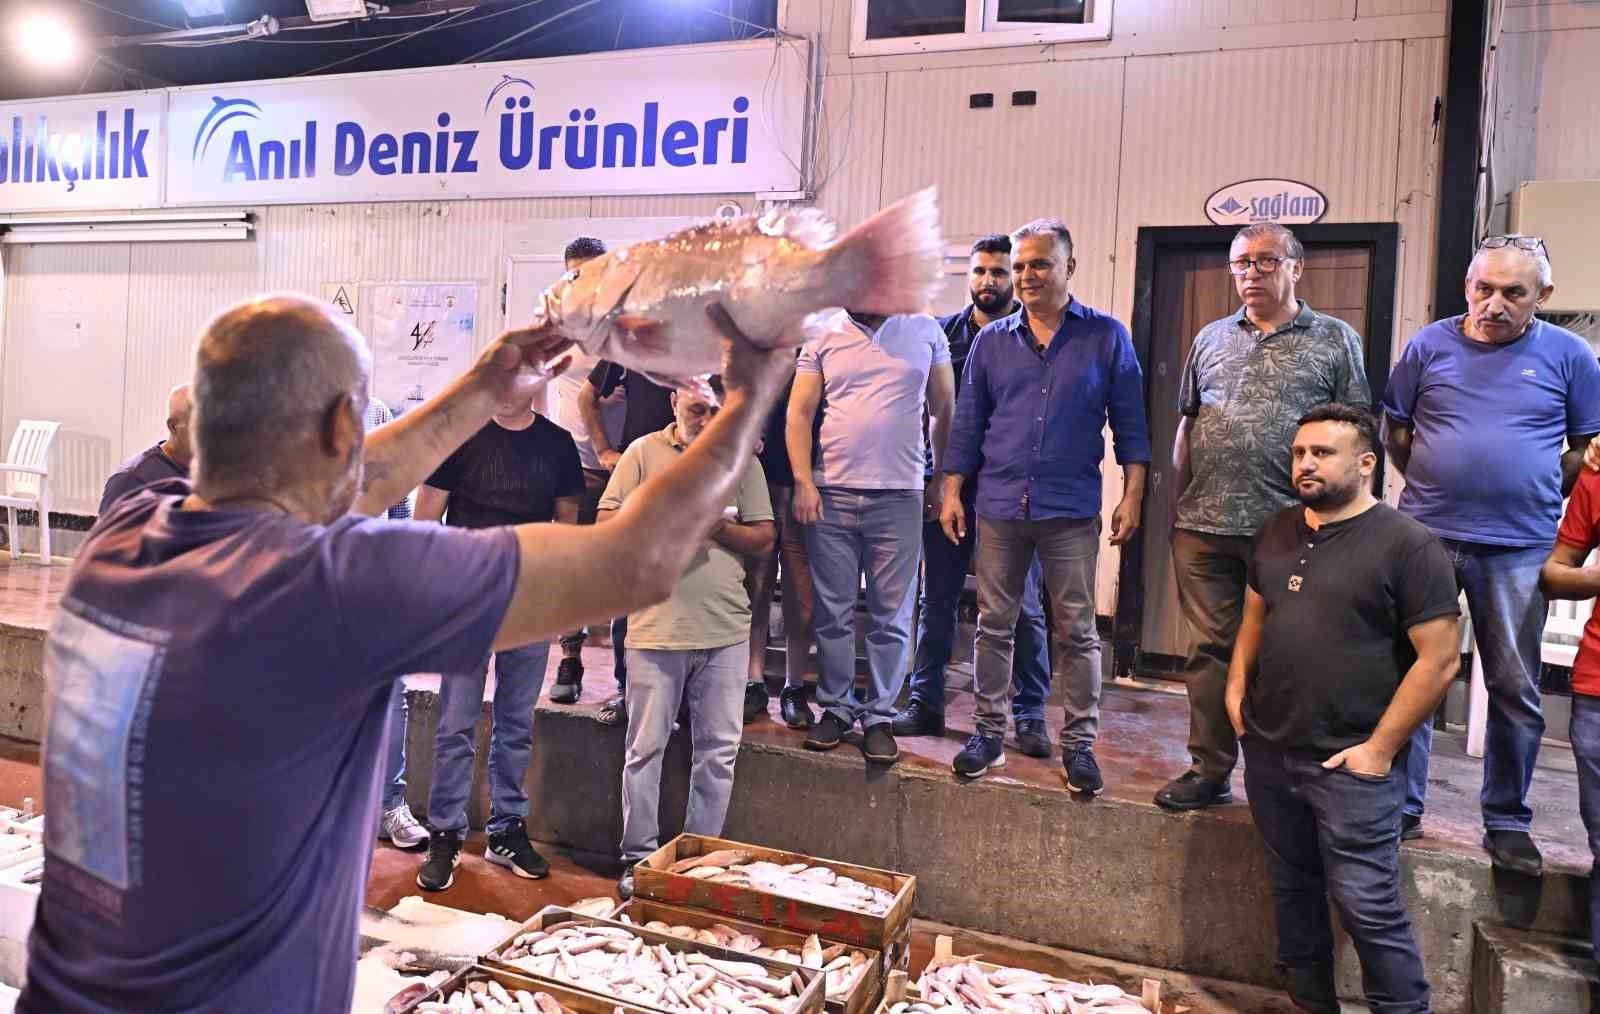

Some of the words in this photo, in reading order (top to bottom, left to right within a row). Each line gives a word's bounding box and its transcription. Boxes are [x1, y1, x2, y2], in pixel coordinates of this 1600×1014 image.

[223, 120, 317, 183] Anıl
[334, 112, 480, 176] Deniz
[499, 95, 750, 171] Ürünleri
[1249, 191, 1320, 220] sağlam
